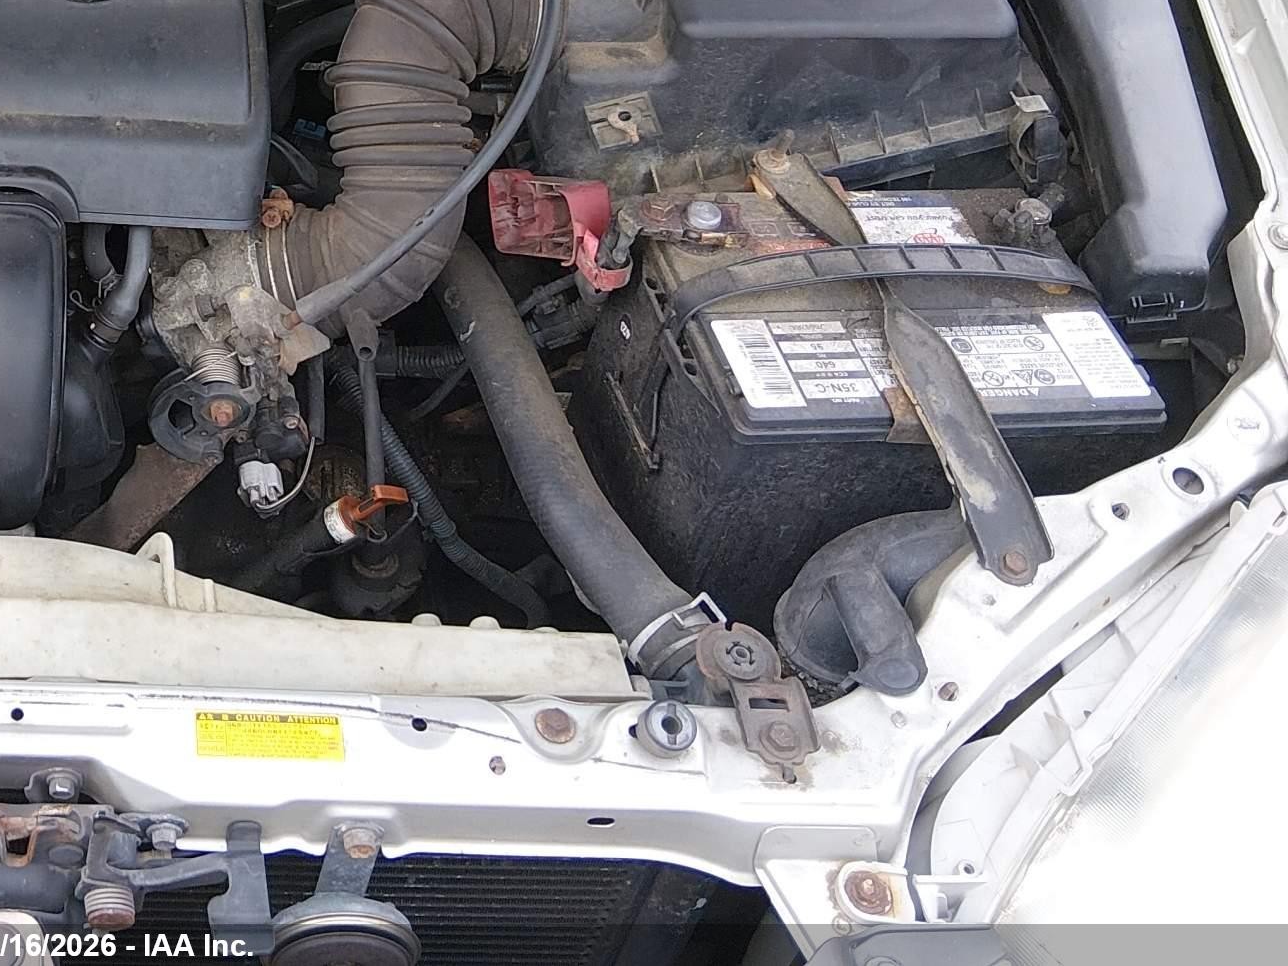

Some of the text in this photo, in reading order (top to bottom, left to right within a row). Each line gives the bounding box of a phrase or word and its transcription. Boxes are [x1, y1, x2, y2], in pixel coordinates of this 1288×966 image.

[815, 360, 836, 369] 640
[814, 382, 857, 395] 35N-C
[977, 387, 1027, 397] DANGER
[235, 714, 281, 722] CAUTION
[287, 715, 336, 725] ATTENTION
